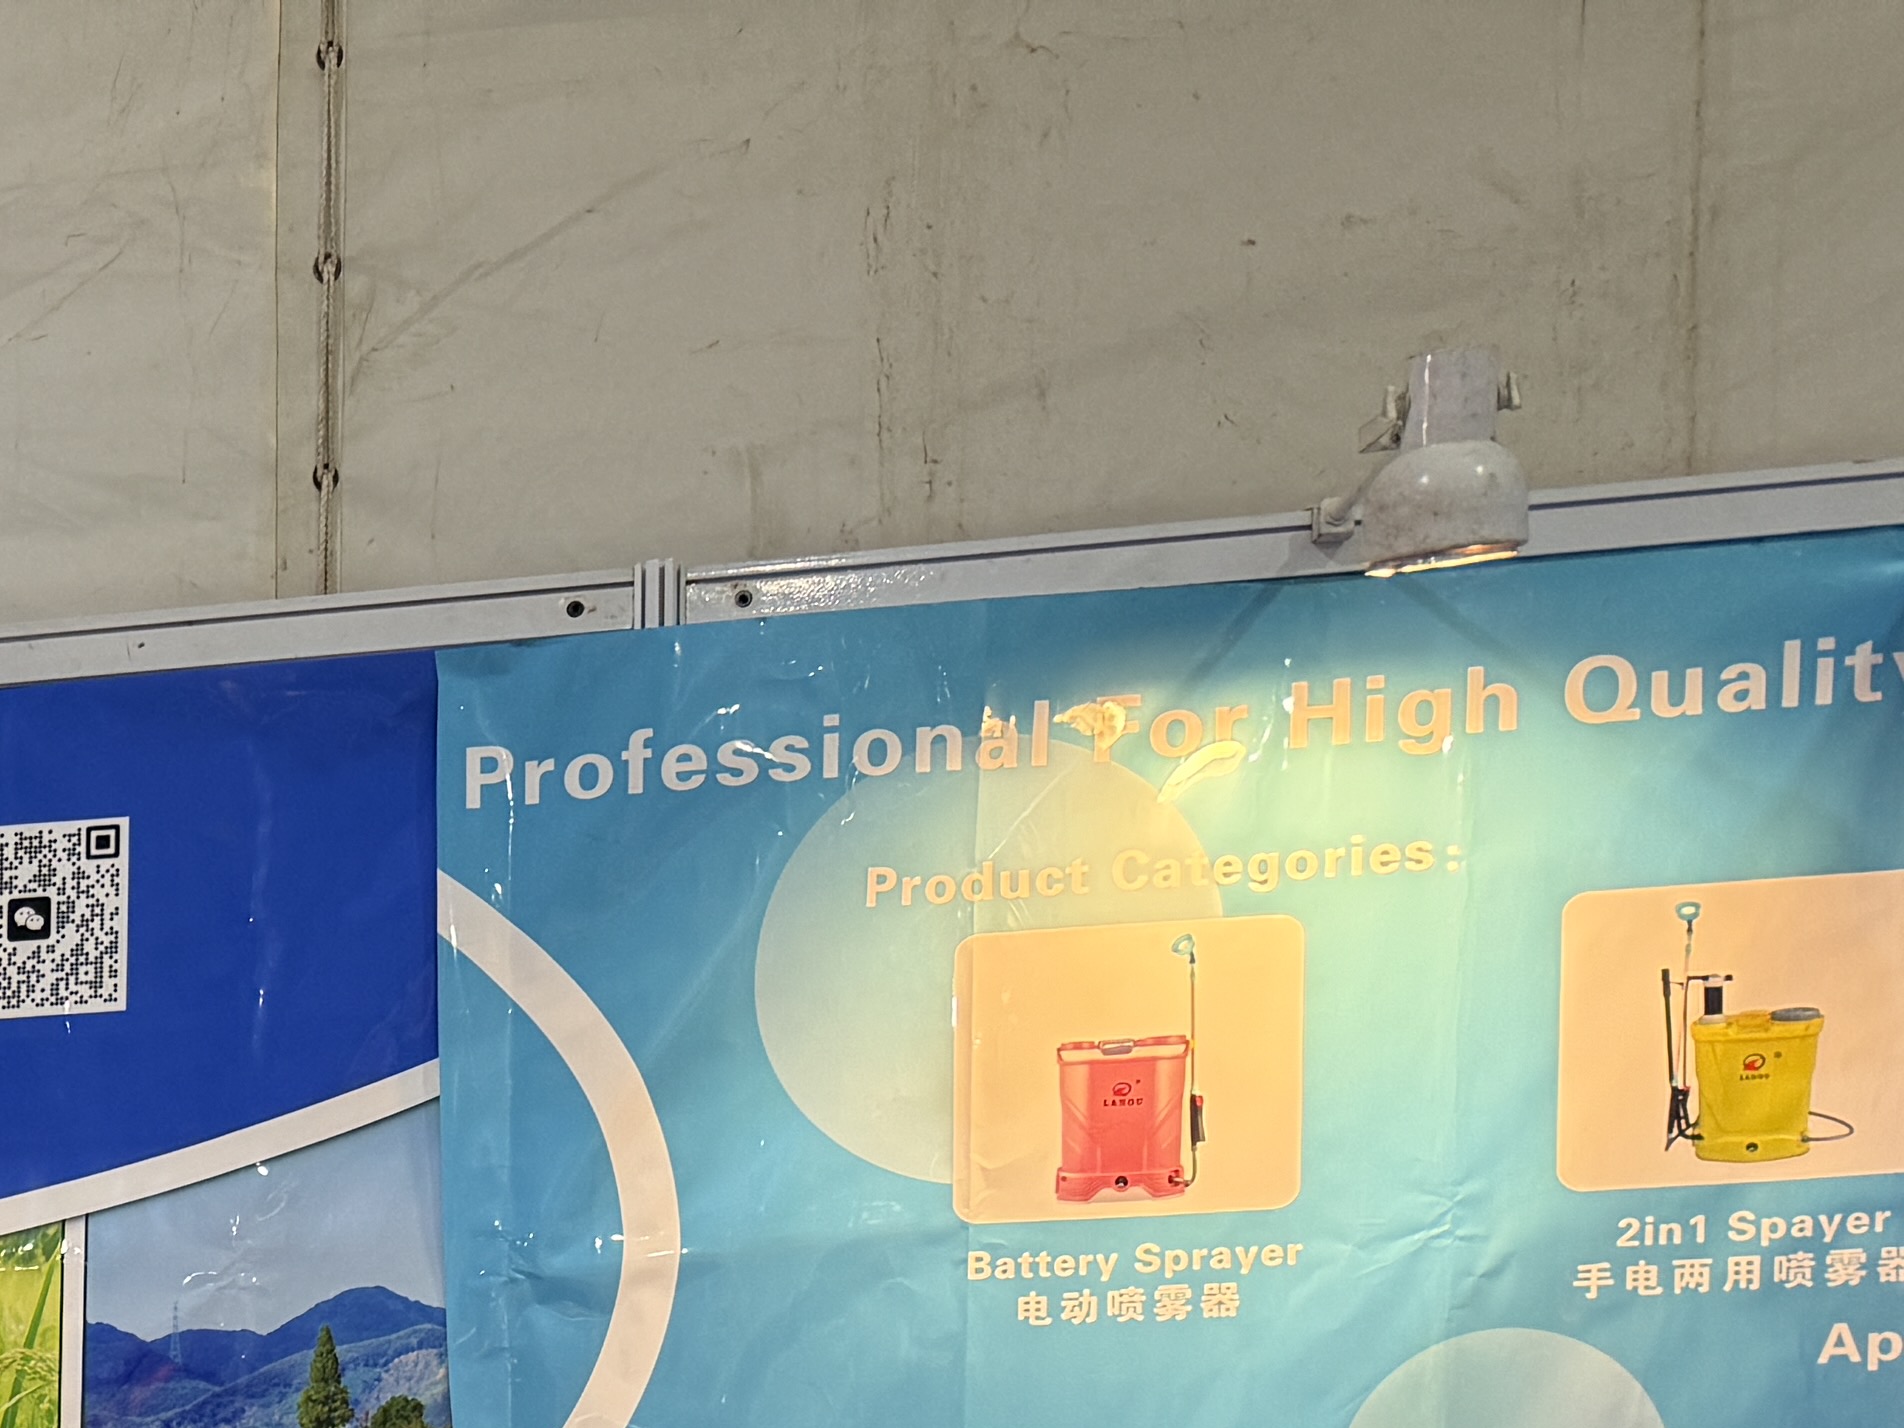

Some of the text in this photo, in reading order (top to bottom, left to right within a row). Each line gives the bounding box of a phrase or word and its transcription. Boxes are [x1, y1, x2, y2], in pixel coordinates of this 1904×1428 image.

[464, 635, 1904, 810] Professional For High Qualit
[865, 834, 1462, 908] Product Categories:
[1616, 1209, 1892, 1248] 2in1 Spayer
[966, 1242, 1303, 1281] Battery Sprayer
[1572, 1246, 1904, 1299] 手电两用喷雾器
[1017, 1282, 1241, 1326] 电动喷雾器
